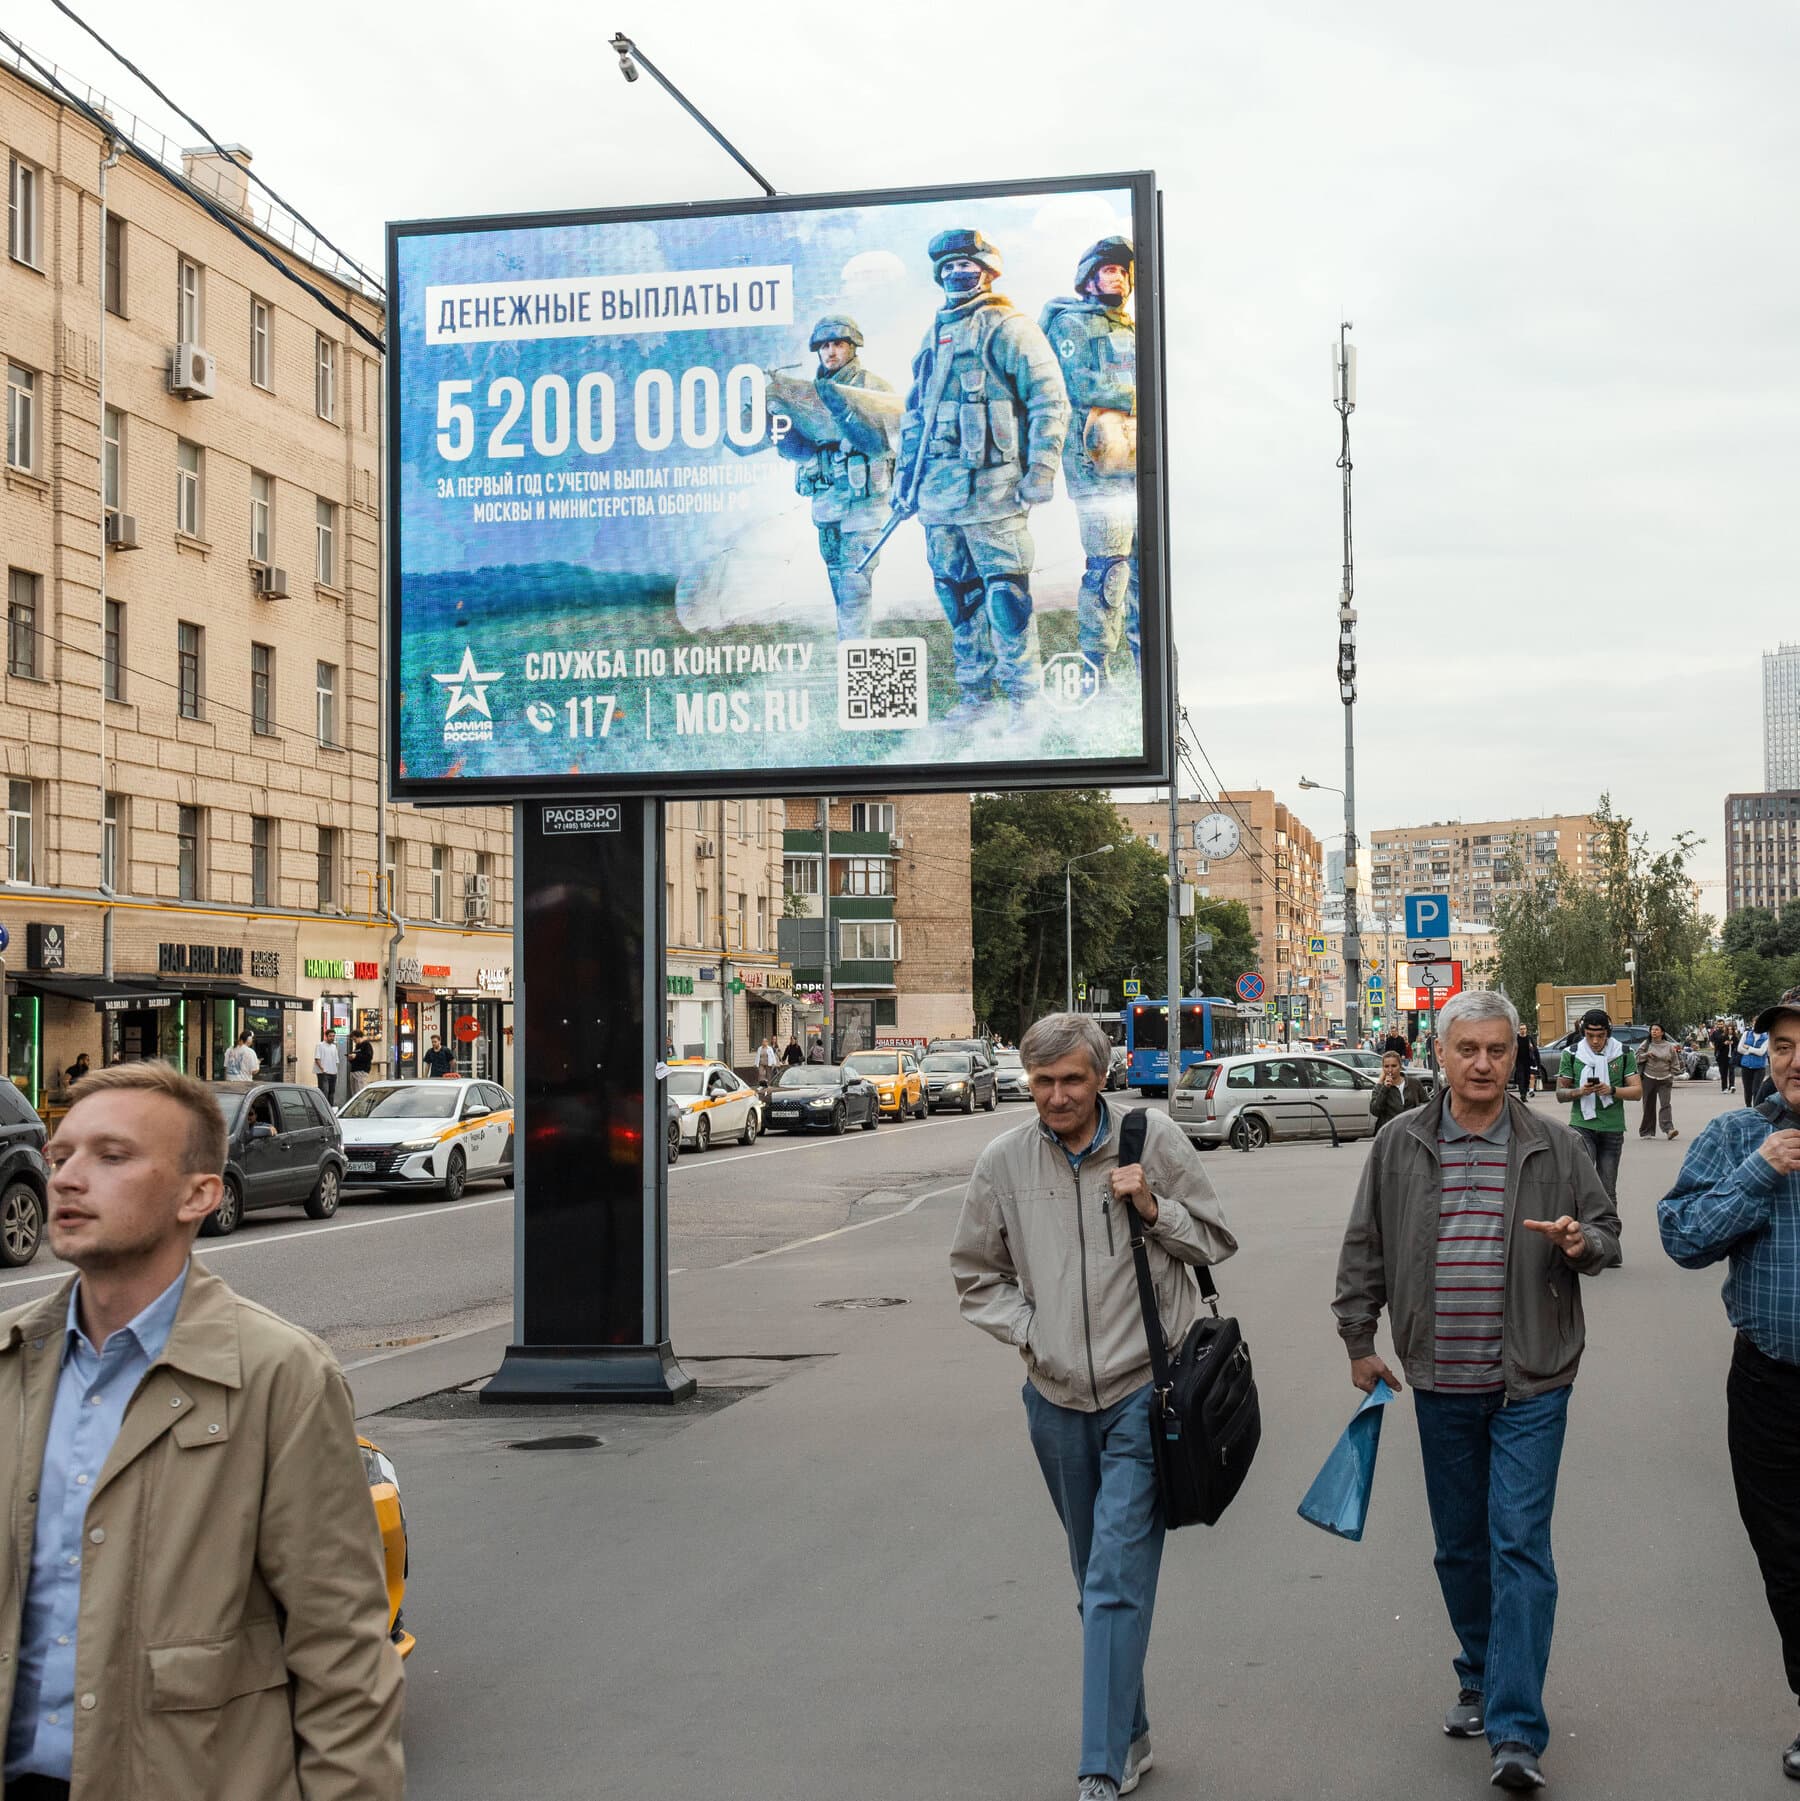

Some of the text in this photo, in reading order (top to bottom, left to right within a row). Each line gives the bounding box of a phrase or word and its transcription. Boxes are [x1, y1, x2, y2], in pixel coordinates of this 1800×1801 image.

[438, 279, 781, 335] ДЕНЕЖНЫЕ ВЫПЛАТЫ ОТ
[436, 379, 475, 462] 5
[486, 371, 616, 459] 200
[437, 477, 455, 499] ЗА
[457, 471, 514, 498] ПЕРВЫЙ
[517, 473, 543, 497] ГОД
[545, 471, 555, 493] С
[557, 469, 610, 492] УЧЕТОМ
[614, 467, 670, 490] ВЫПЛАТ
[473, 500, 533, 523] МОСКВЫ
[536, 499, 545, 521] И
[549, 494, 655, 520] МИНИСТЕРСТВА
[658, 491, 723, 515] ОБОРОНЫ
[525, 641, 814, 682] СЛУЖБА ПО КОНТРАКТУ
[1049, 662, 1095, 702] 18+
[443, 720, 493, 732] АРМИЯ
[564, 687, 810, 739] 117 MOS.RU
[443, 731, 493, 743] РОССИИ
[545, 807, 618, 824] РАСВЭРО
[1416, 900, 1440, 934] P
[305, 960, 345, 978] НАПИТКИ
